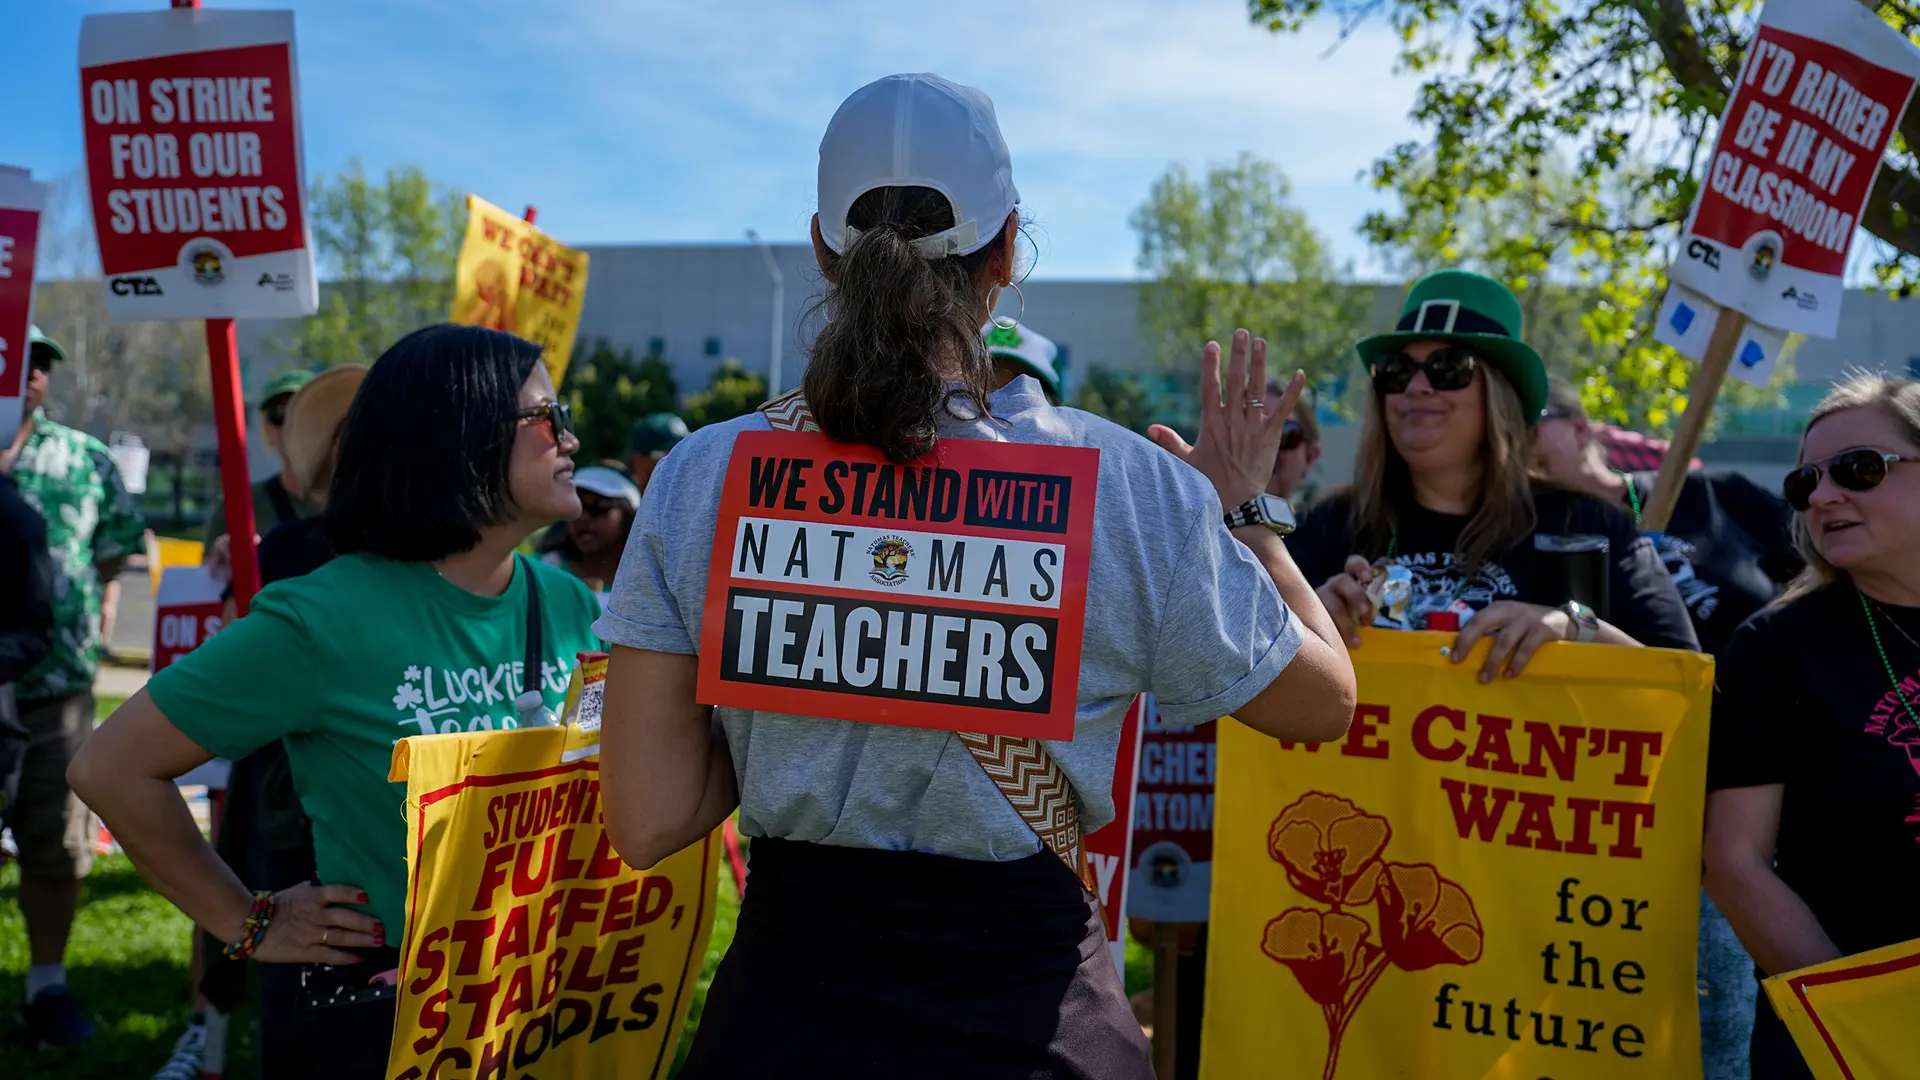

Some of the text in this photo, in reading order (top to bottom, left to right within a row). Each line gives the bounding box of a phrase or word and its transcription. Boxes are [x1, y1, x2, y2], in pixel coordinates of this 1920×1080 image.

[91, 76, 275, 125] ON STRIKE
[1745, 38, 1890, 152] I'D RATHER
[110, 131, 262, 179] FOR OUR
[1734, 99, 1857, 197] BE IN MY
[107, 185, 288, 234] STUDENTS
[1710, 151, 1855, 254] CLASSROOM
[748, 456, 1061, 525] WE STAND WITH
[161, 614, 198, 648] ON
[733, 594, 1048, 705] TEACHERS
[1863, 669, 1920, 736] NATOM
[1411, 704, 1663, 788] CAN'T
[484, 779, 604, 850] STUDENT
[1133, 792, 1214, 832] ATOM
[1440, 777, 1655, 859] WAIT
[471, 828, 638, 912] FULL
[1555, 877, 1649, 931] for
[410, 875, 684, 996] STAFFED,
[1541, 941, 1647, 995] the
[413, 934, 645, 1056] STABLE
[1432, 983, 1646, 1059] future
